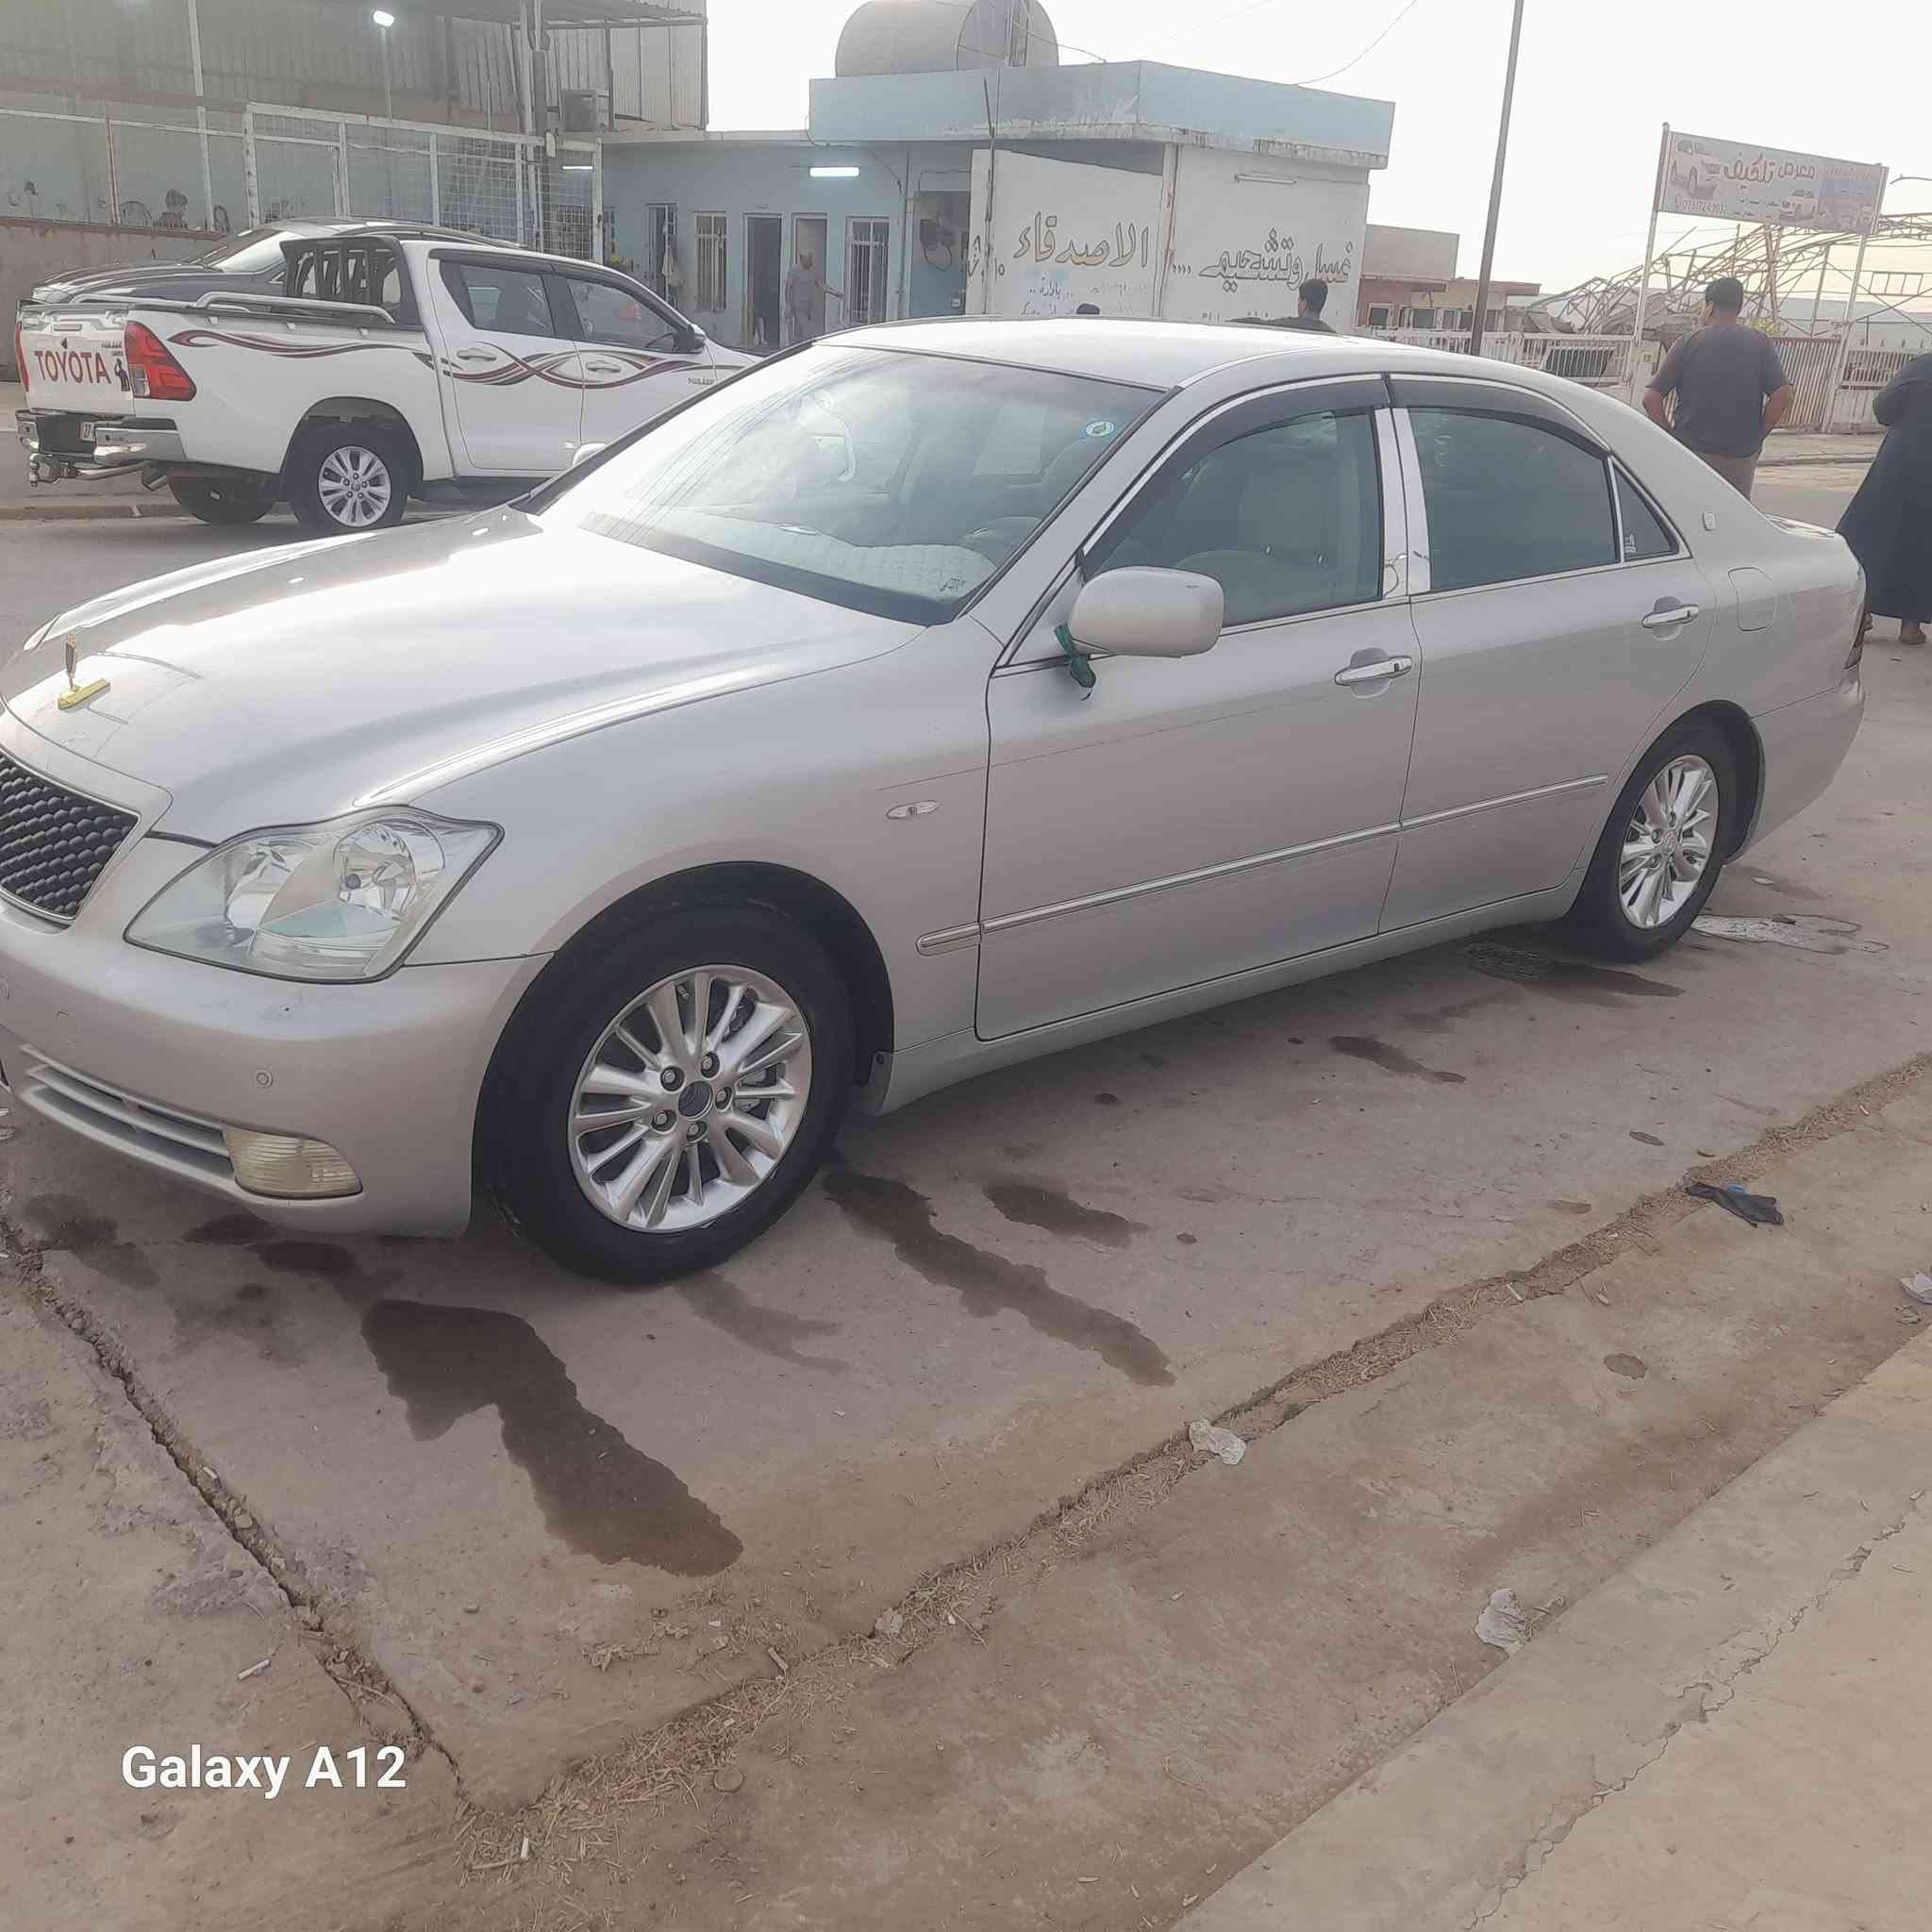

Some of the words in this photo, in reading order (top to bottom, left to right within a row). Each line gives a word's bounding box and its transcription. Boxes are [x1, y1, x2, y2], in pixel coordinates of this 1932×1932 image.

[1013, 211, 1149, 269] الاصدقاء
[1198, 227, 1304, 293] وتشحيم
[34, 350, 111, 384] TOYOTA
